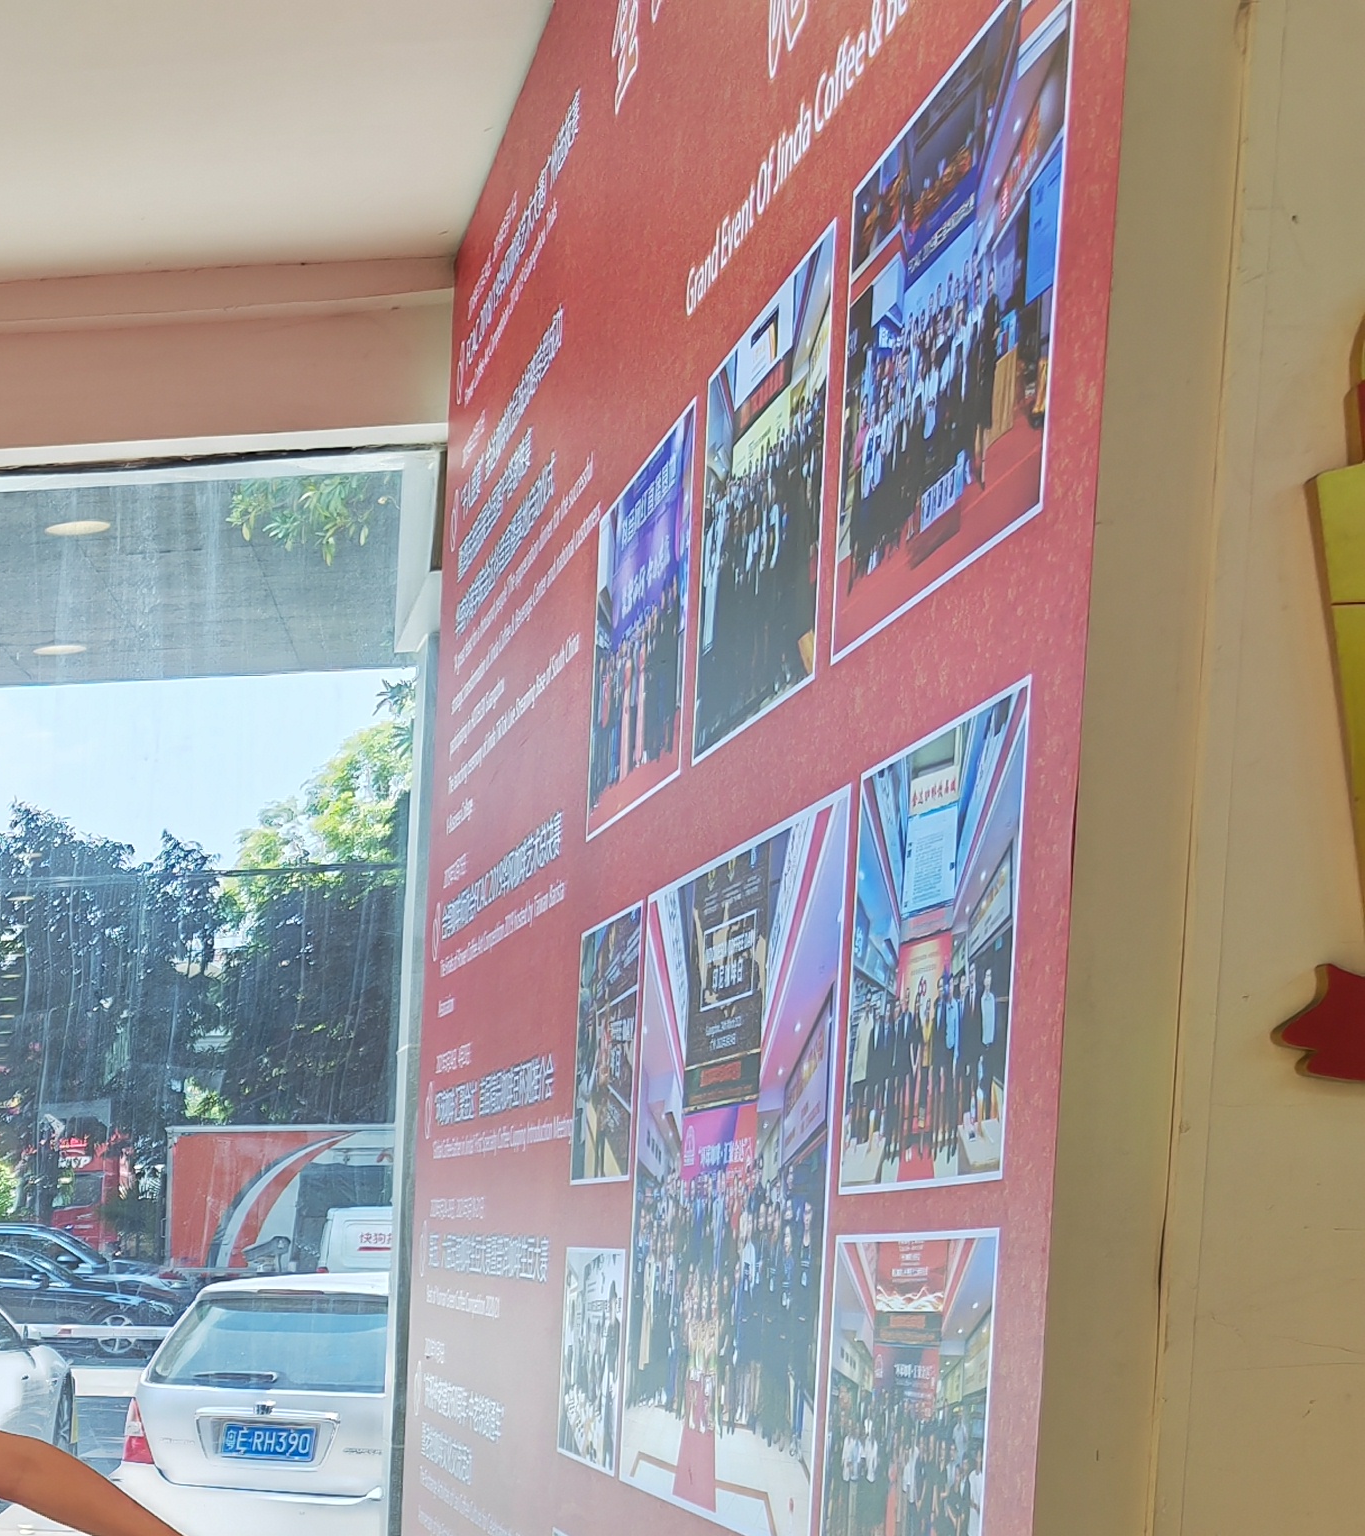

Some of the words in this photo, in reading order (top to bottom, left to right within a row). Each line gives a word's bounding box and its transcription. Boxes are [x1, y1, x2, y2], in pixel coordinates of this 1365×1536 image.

[686, 228, 720, 316] Grand
[720, 183, 754, 269] Event
[756, 146, 774, 215] Of
[773, 103, 811, 195] Jinda
[814, 30, 867, 132] Coffee
